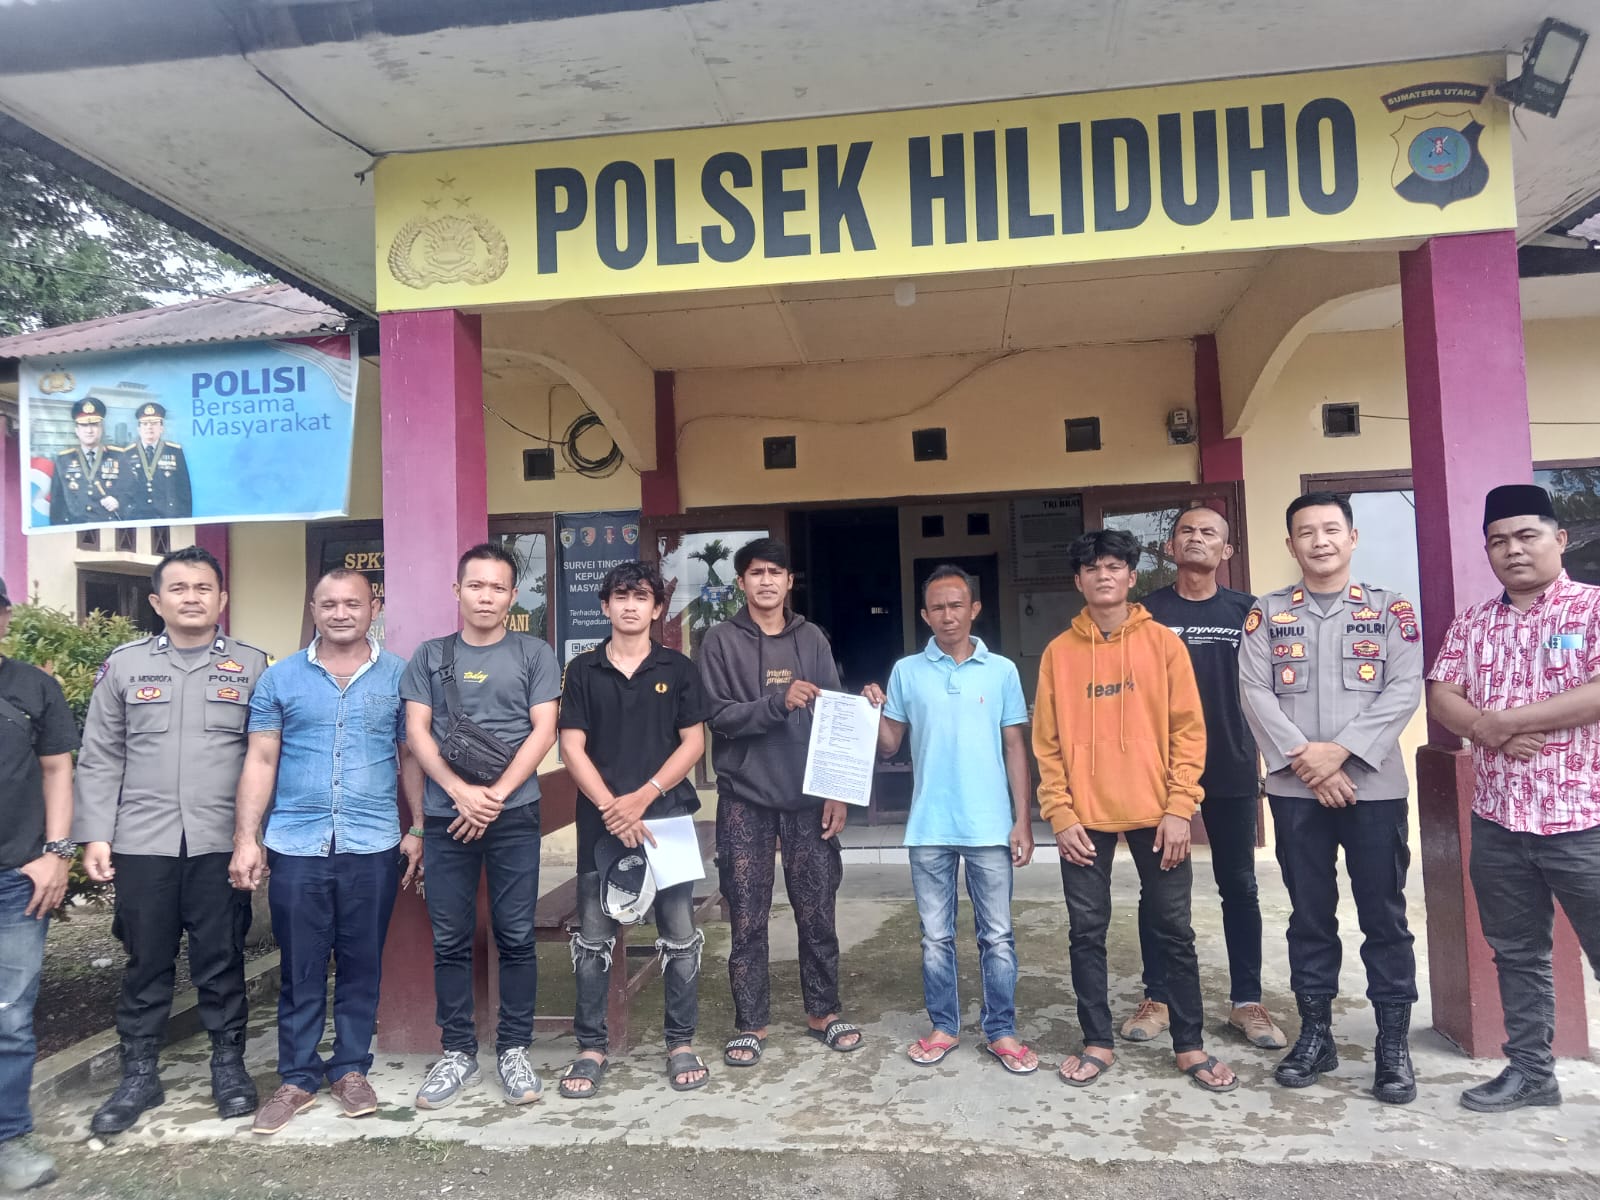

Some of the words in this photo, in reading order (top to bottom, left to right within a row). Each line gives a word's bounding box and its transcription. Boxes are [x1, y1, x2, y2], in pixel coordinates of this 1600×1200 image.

[1388, 89, 1441, 105] SUMATERA
[1444, 88, 1477, 97] UTARA
[535, 141, 877, 275] POLSEK
[908, 97, 1359, 247] HILIDUHO
[192, 366, 305, 398] POLISI
[192, 397, 295, 417] Bersama
[192, 412, 331, 439] Masyarakat
[563, 561, 595, 570] SURVEI
[575, 572, 608, 581] KEPUA
[1186, 626, 1242, 635] DYNAFIT
[1347, 624, 1385, 634] POLRI
[208, 675, 249, 684] POLRI
